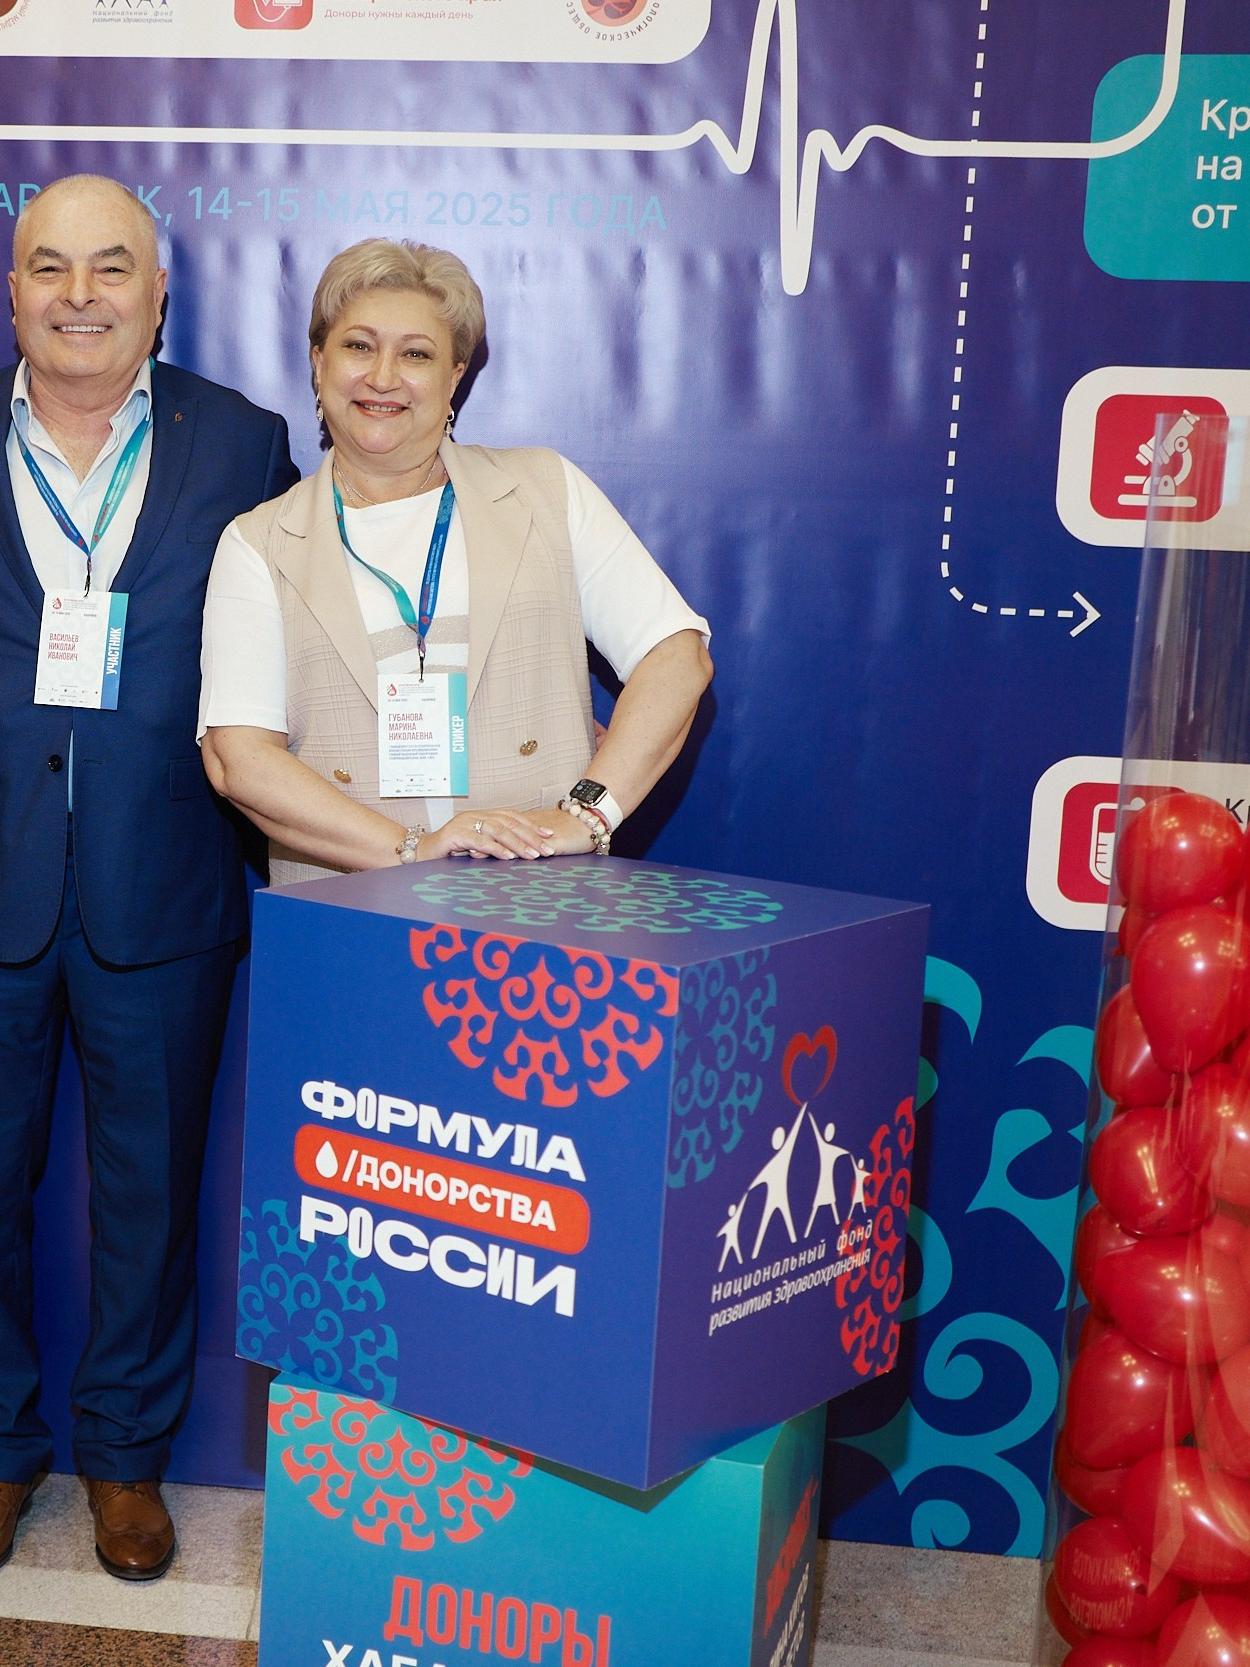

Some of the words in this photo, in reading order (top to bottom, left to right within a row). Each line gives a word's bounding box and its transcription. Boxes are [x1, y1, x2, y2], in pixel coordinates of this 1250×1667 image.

[324, 9, 366, 19] Доноры
[368, 11, 403, 20] нужны
[405, 10, 446, 21] каждый
[448, 11, 474, 21] день
[1201, 99, 1250, 139] Кр
[1196, 155, 1242, 180] на
[188, 186, 299, 222] 14-15
[315, 187, 410, 224] МАЯ
[425, 190, 530, 227] 2025
[547, 193, 667, 236] ГОДА
[1192, 204, 1237, 229] от
[48, 642, 76, 652] НИКОЛАЙ
[49, 633, 79, 643] ВАСИЛЬЕВ
[106, 627, 122, 675] УЧАСТНИК
[47, 651, 78, 661] ИВАНОВИЧ
[388, 713, 423, 722] ГУБАНОВА
[388, 722, 417, 731] МАРИНА
[388, 731, 433, 741] НИКОЛАЕВНА
[452, 715, 465, 753] СПИКЕР
[301, 1080, 587, 1182] ФОРМУЛА
[299, 1195, 577, 1317] РОССИИ
[711, 1239, 826, 1303] Национальный
[836, 1219, 873, 1254] фонд
[708, 1291, 772, 1336] развития
[773, 1247, 871, 1304] здравоохранения
[383, 1575, 612, 1667] ДОНОРЫ
